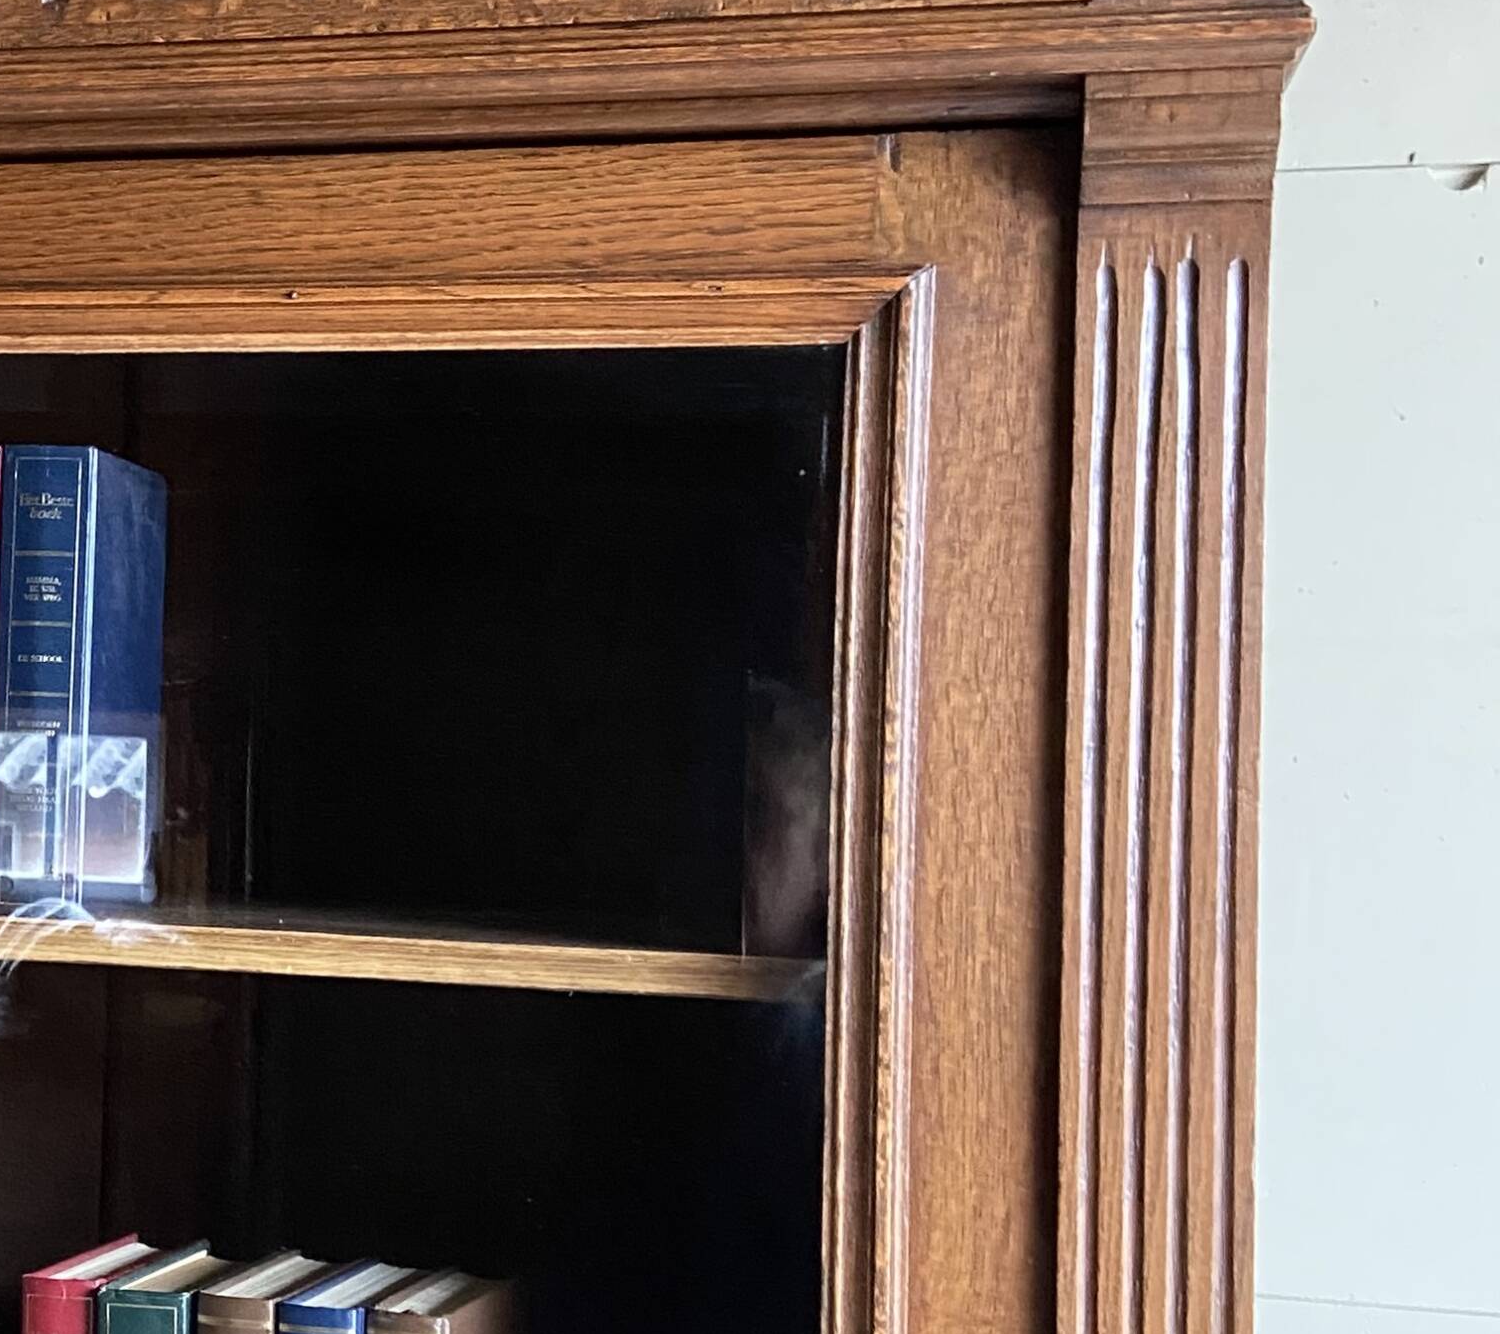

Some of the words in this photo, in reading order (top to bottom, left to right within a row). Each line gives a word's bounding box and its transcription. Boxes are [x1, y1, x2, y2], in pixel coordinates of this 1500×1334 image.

[20, 493, 41, 507] Het
[41, 493, 74, 508] Beste
[30, 507, 63, 520] boek
